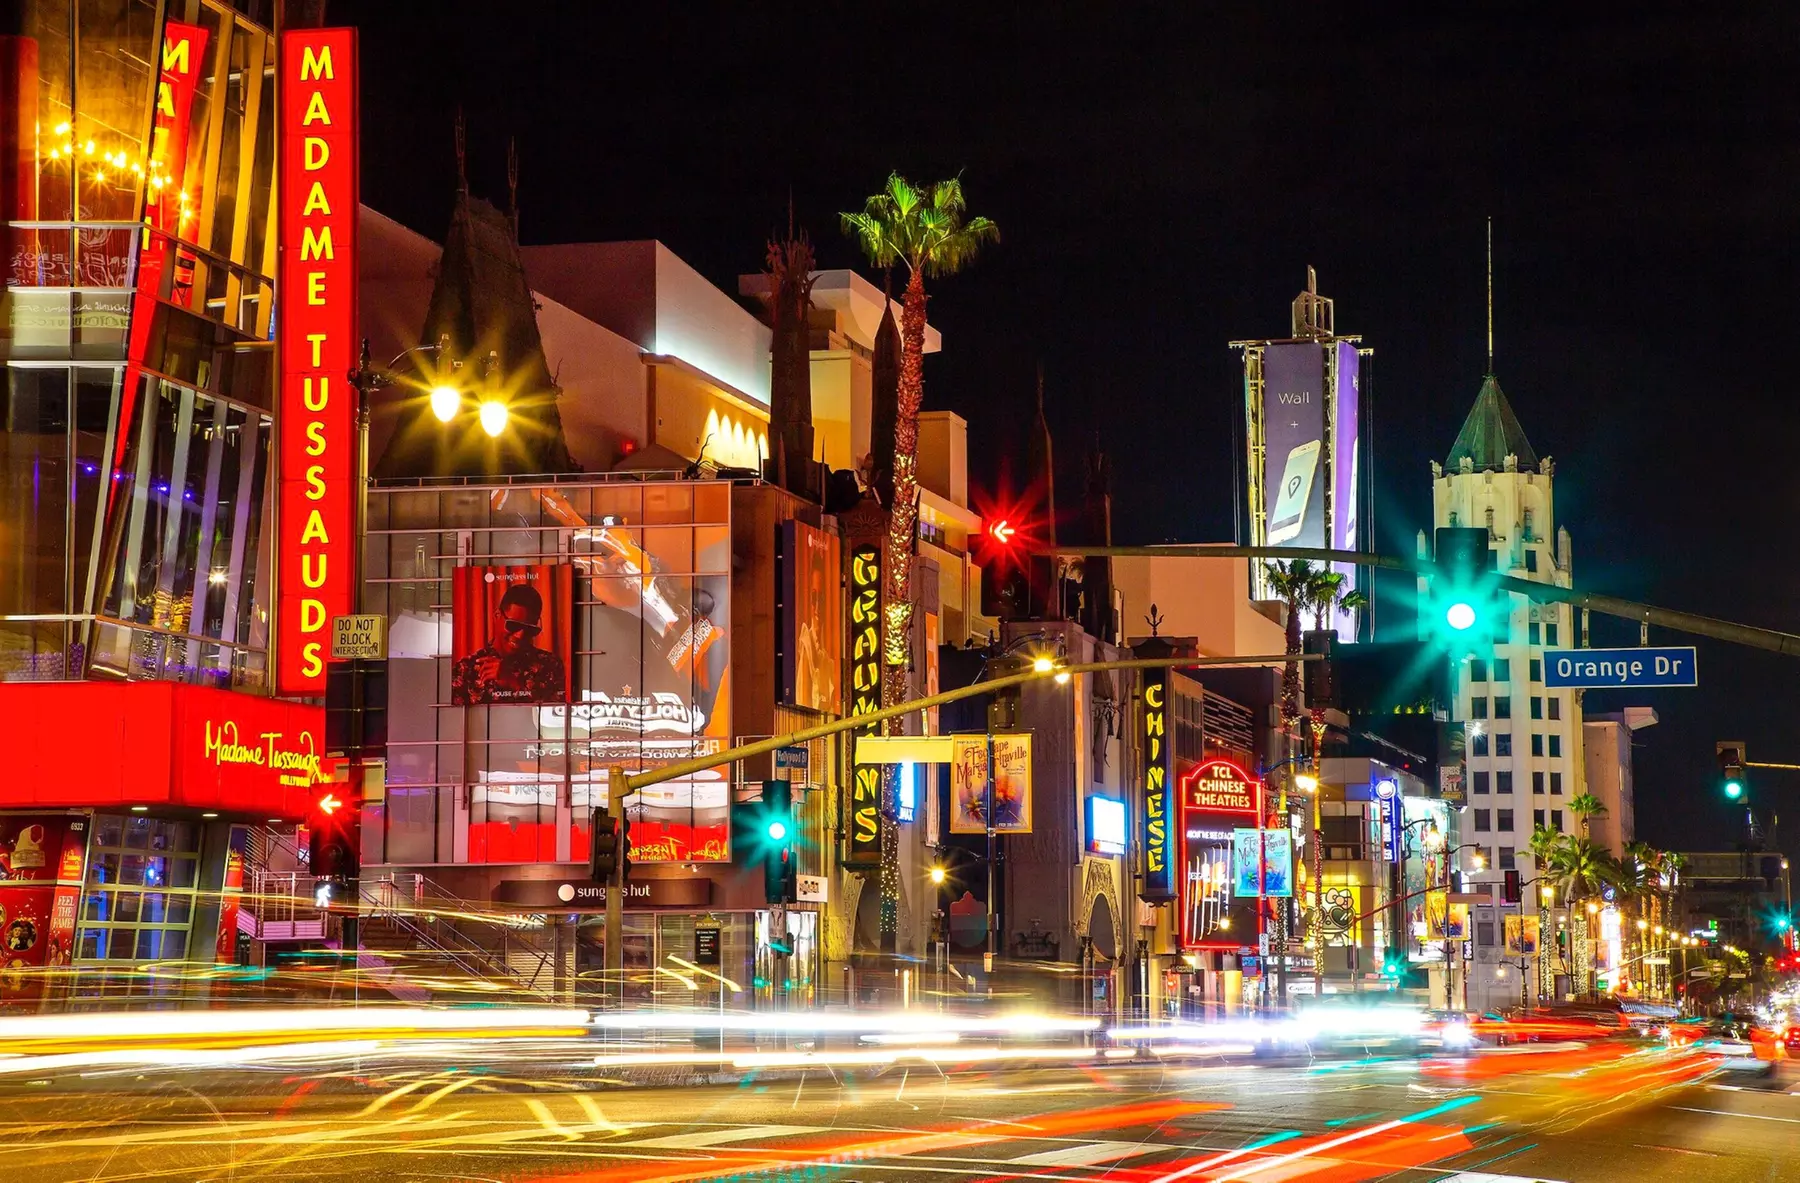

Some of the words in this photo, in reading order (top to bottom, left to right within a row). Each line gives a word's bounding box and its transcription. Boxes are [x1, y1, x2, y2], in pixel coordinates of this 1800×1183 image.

[301, 46, 334, 306] MADAME
[1278, 392, 1310, 405] Wall
[300, 334, 330, 678] TUSSAUDS
[527, 572, 539, 580] hut
[338, 619, 351, 631] DO
[356, 619, 375, 631] NOT
[340, 633, 371, 645] BLOCK
[1557, 658, 1643, 682] Orange
[1655, 656, 1682, 676] Dr
[205, 720, 265, 766] Madame
[261, 731, 323, 784] Tussauds
[1145, 683, 1165, 872] CHINESE
[1212, 766, 1232, 779] TCL
[1199, 778, 1246, 794] CHINESE
[1194, 793, 1250, 808] THEATRES
[577, 885, 627, 900] sungs
[631, 884, 651, 897] hut
[58, 906, 73, 918] THE
